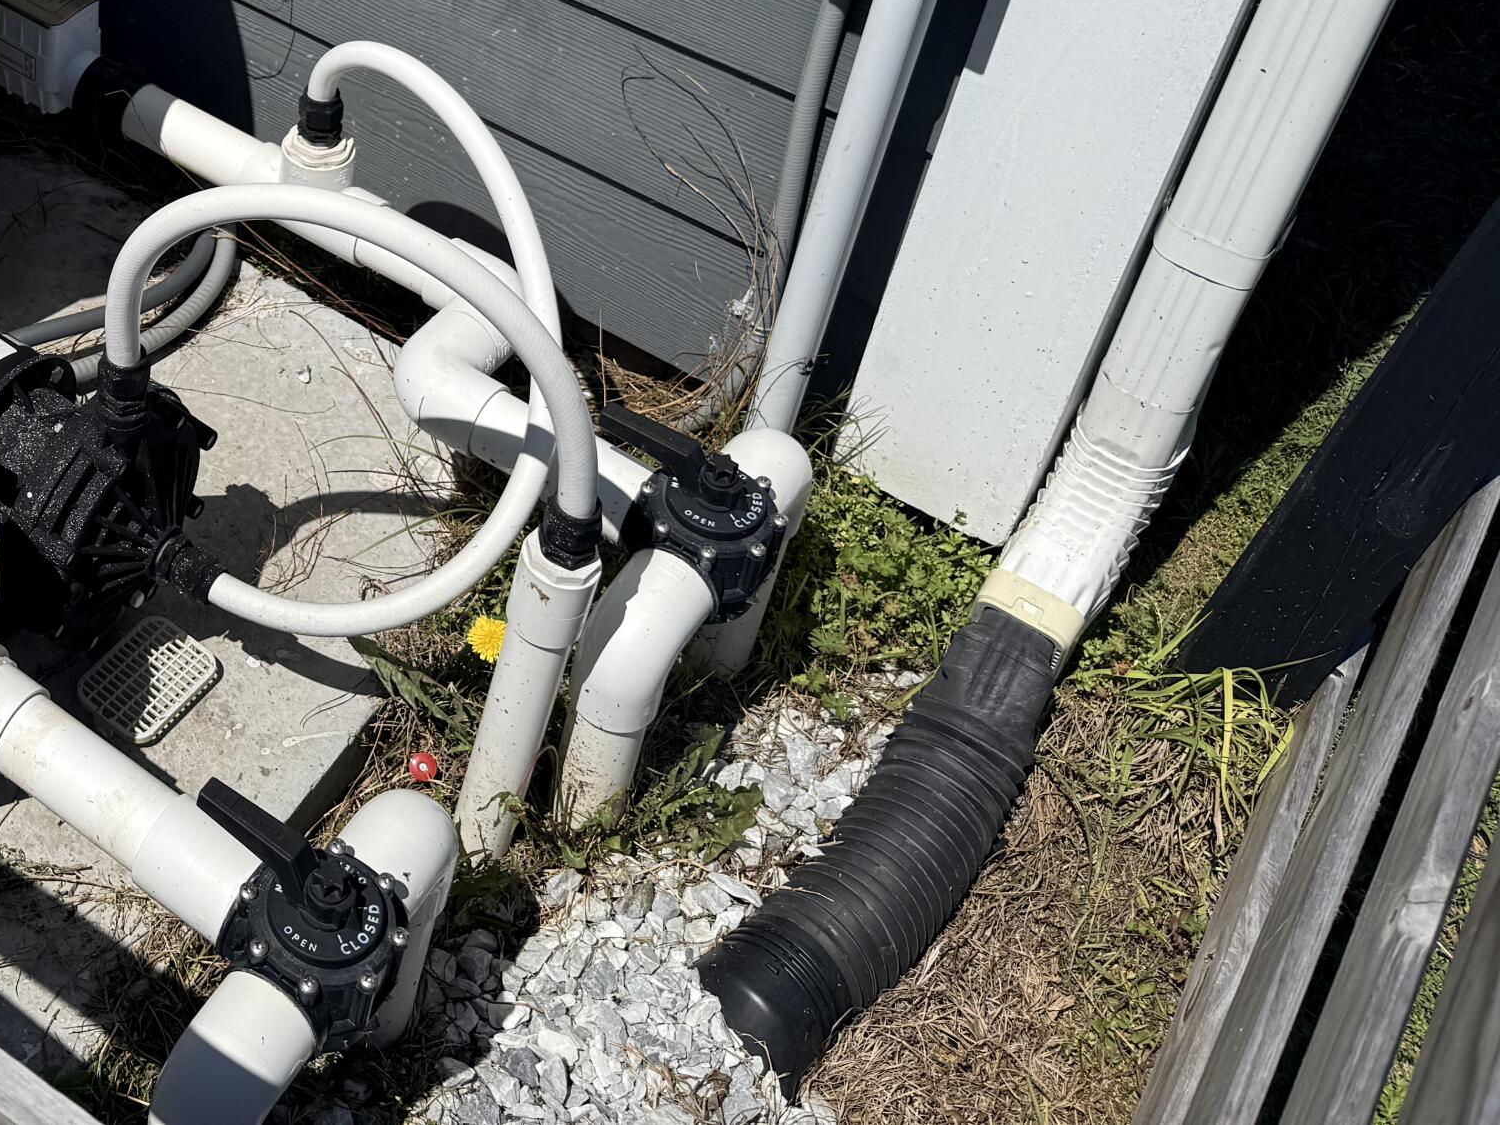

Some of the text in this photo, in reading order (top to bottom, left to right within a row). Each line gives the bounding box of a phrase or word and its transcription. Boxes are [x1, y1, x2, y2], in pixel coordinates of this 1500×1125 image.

[684, 510, 715, 528] OPEN
[734, 492, 763, 529] CLOSED
[284, 926, 318, 953] OPEN
[340, 904, 380, 955] CLOSED
